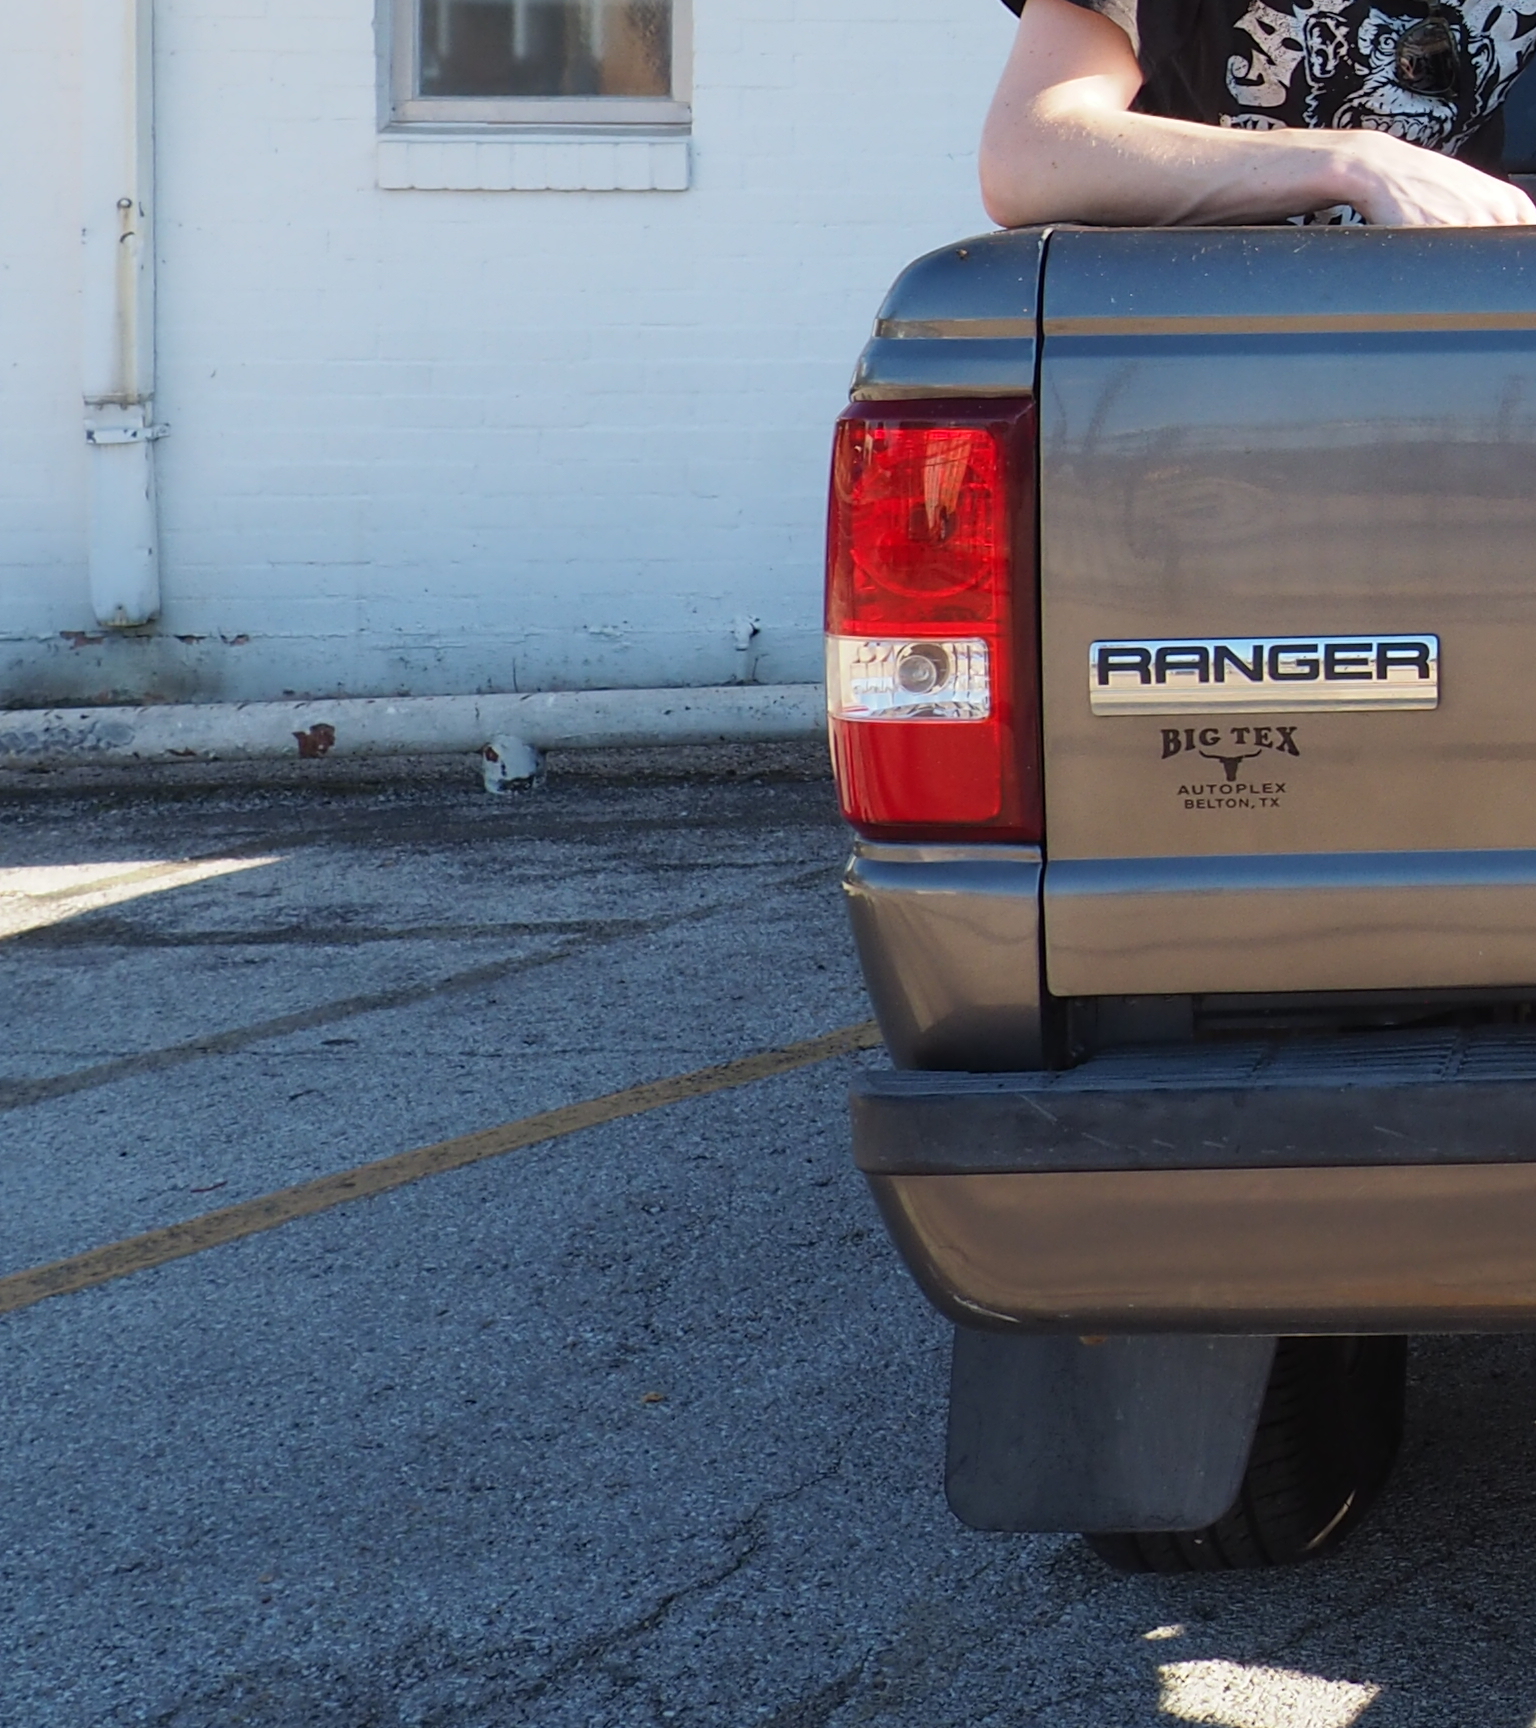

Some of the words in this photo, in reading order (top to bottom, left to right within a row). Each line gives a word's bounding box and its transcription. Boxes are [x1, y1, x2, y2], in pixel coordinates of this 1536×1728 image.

[1096, 641, 1432, 686] RANGER
[1159, 727, 1221, 760] BIG
[1230, 725, 1301, 757] TEX
[1177, 782, 1287, 796] AUTOPLEX
[1184, 797, 1257, 810] BELTON,
[1259, 797, 1281, 808] TX
